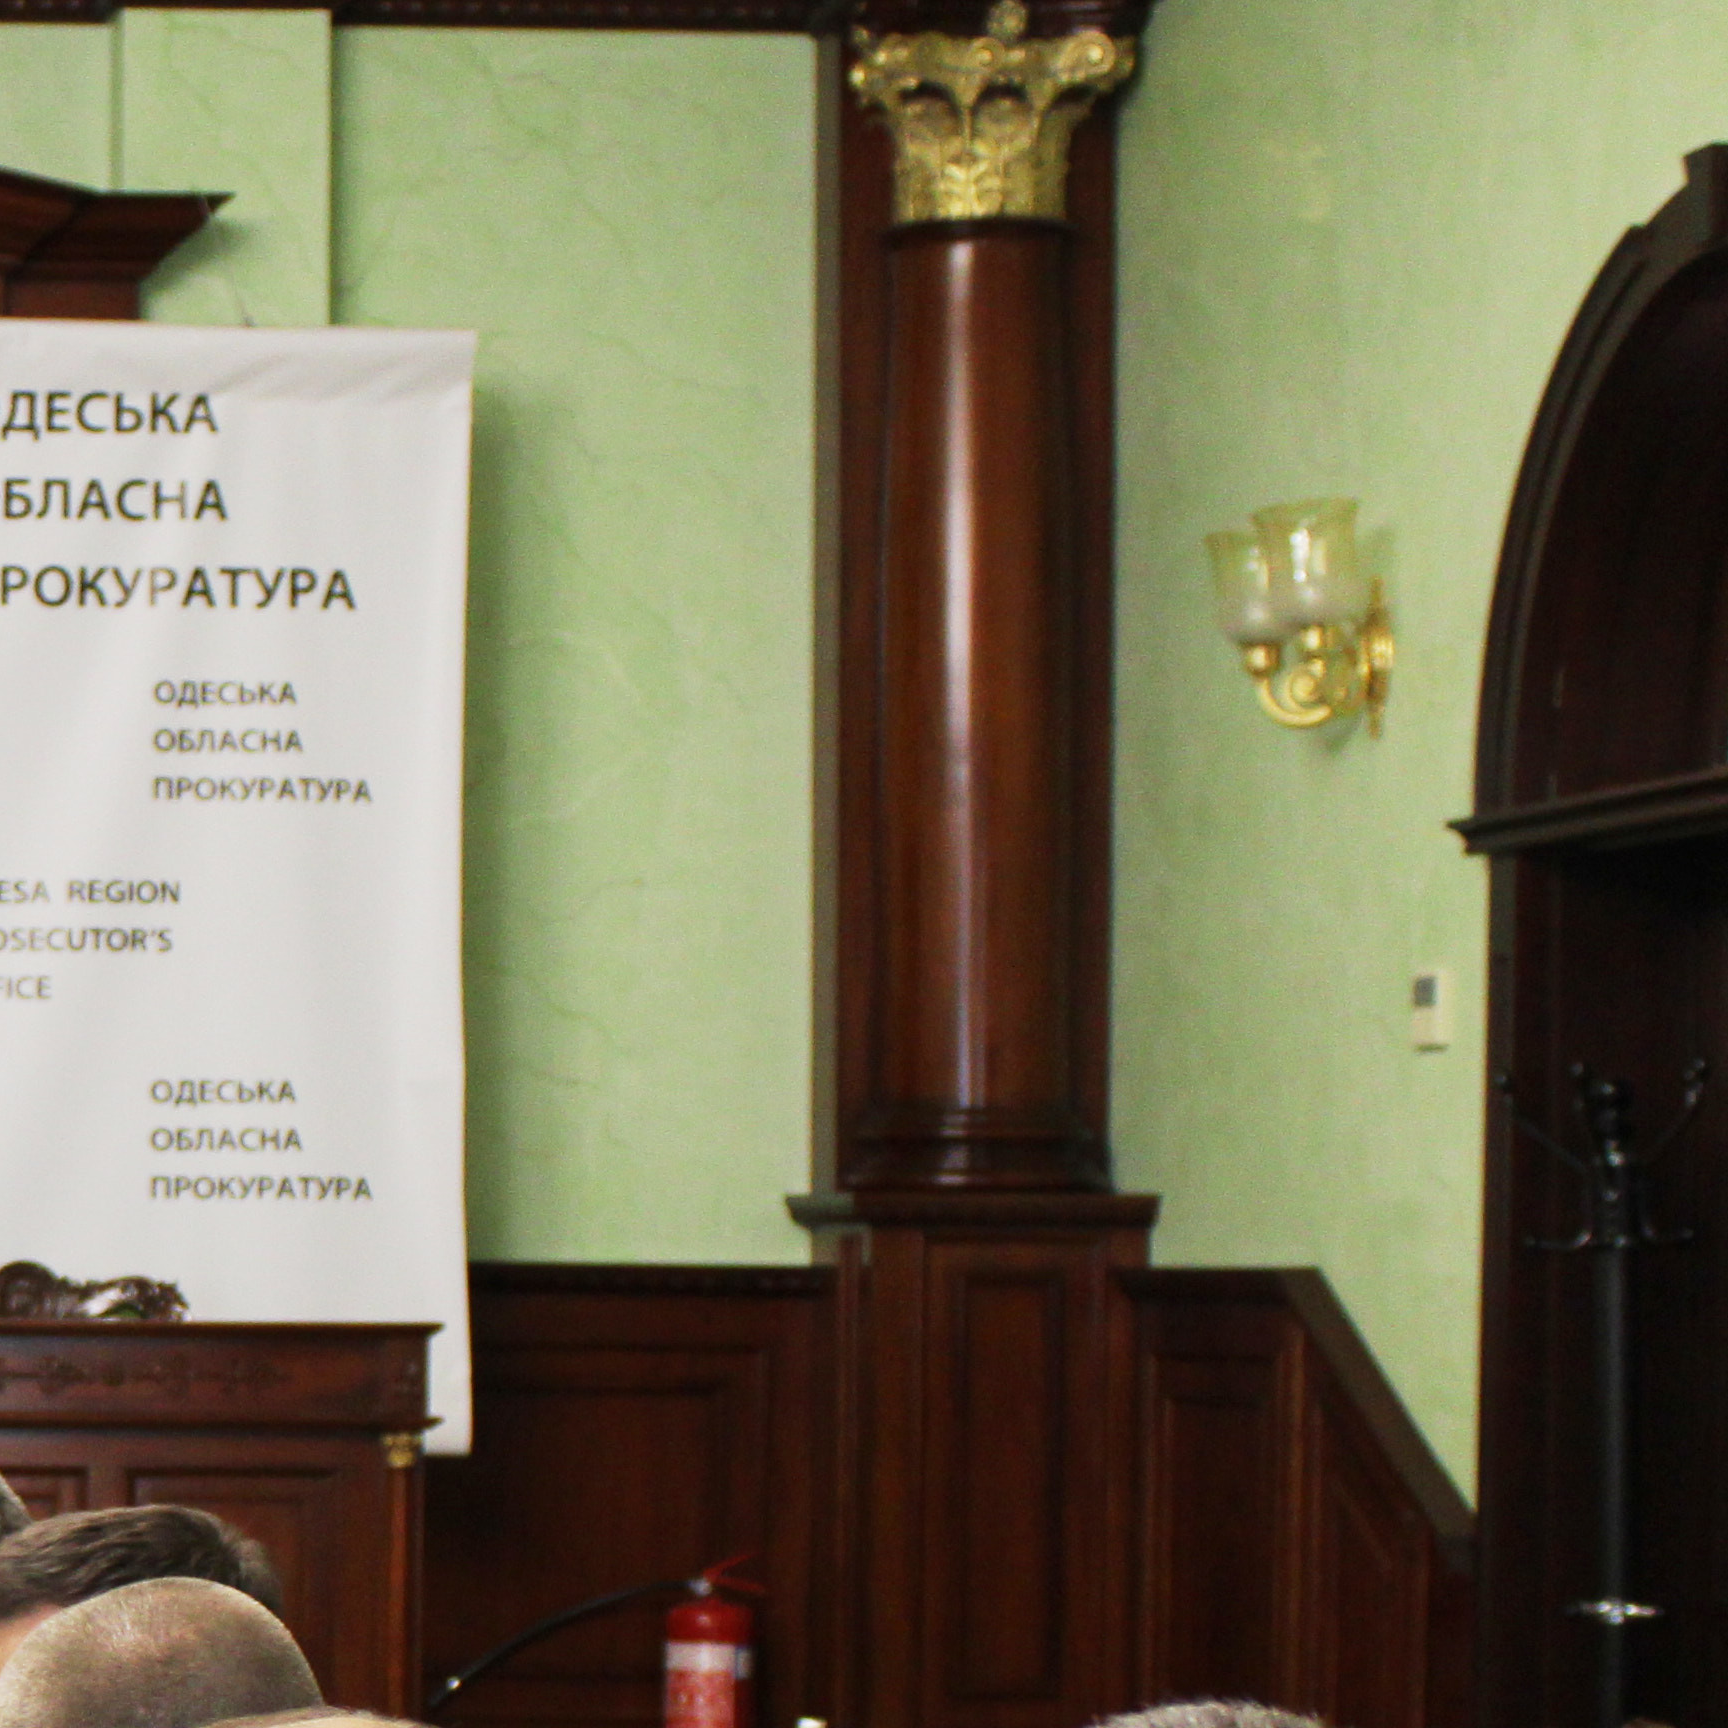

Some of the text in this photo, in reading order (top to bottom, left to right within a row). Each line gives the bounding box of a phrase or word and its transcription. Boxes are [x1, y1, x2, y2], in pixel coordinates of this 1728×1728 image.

[152, 679, 298, 710] ОДЕСЬКА
[151, 727, 303, 754] ОБЛАСНА
[151, 775, 373, 804] ПРОКУРАТУРА
[67, 878, 181, 905] REGION
[149, 1078, 297, 1108] ОДЕСЬКА
[149, 1127, 303, 1153] ОБЛАСНА
[149, 1175, 373, 1201] ПРОКУРАТУРА
